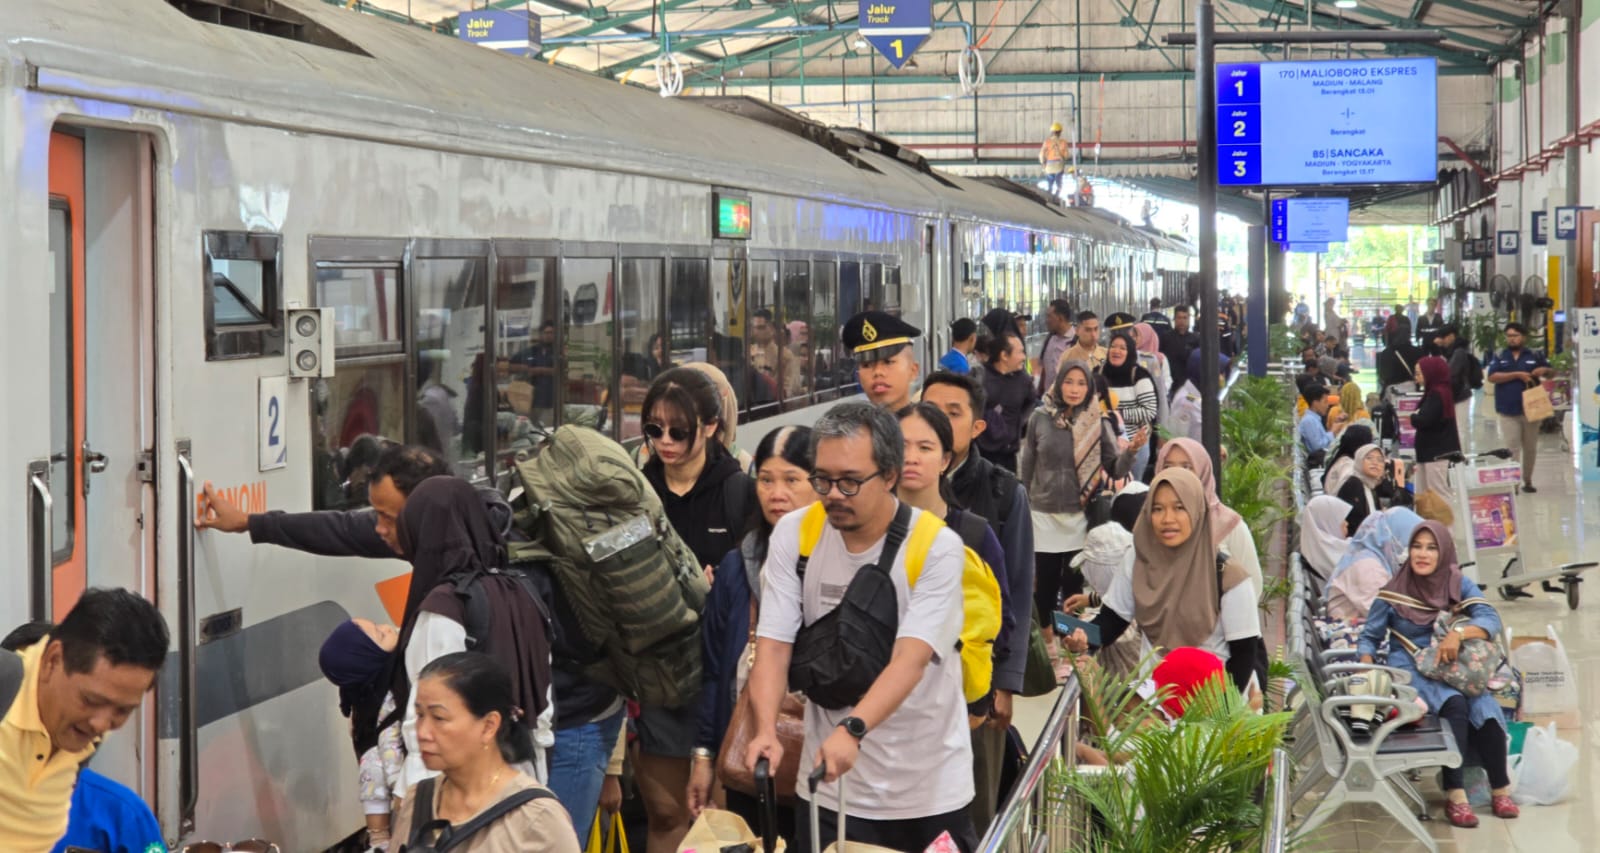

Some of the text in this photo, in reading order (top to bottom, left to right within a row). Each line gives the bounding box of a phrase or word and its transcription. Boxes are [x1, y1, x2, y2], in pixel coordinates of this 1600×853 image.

[867, 3, 896, 14] Jalur
[466, 18, 495, 29] Jalur
[868, 15, 889, 24] Track
[467, 29, 489, 38] Track
[889, 39, 903, 59] 1
[1370, 66, 1418, 77] EKSPRES
[1234, 80, 1244, 97] 1
[1233, 120, 1246, 137] 2
[1329, 128, 1366, 136] Berangkat
[1233, 160, 1247, 177] 3
[1341, 159, 1392, 167] YOGYAKARTA
[268, 396, 279, 446] 2
